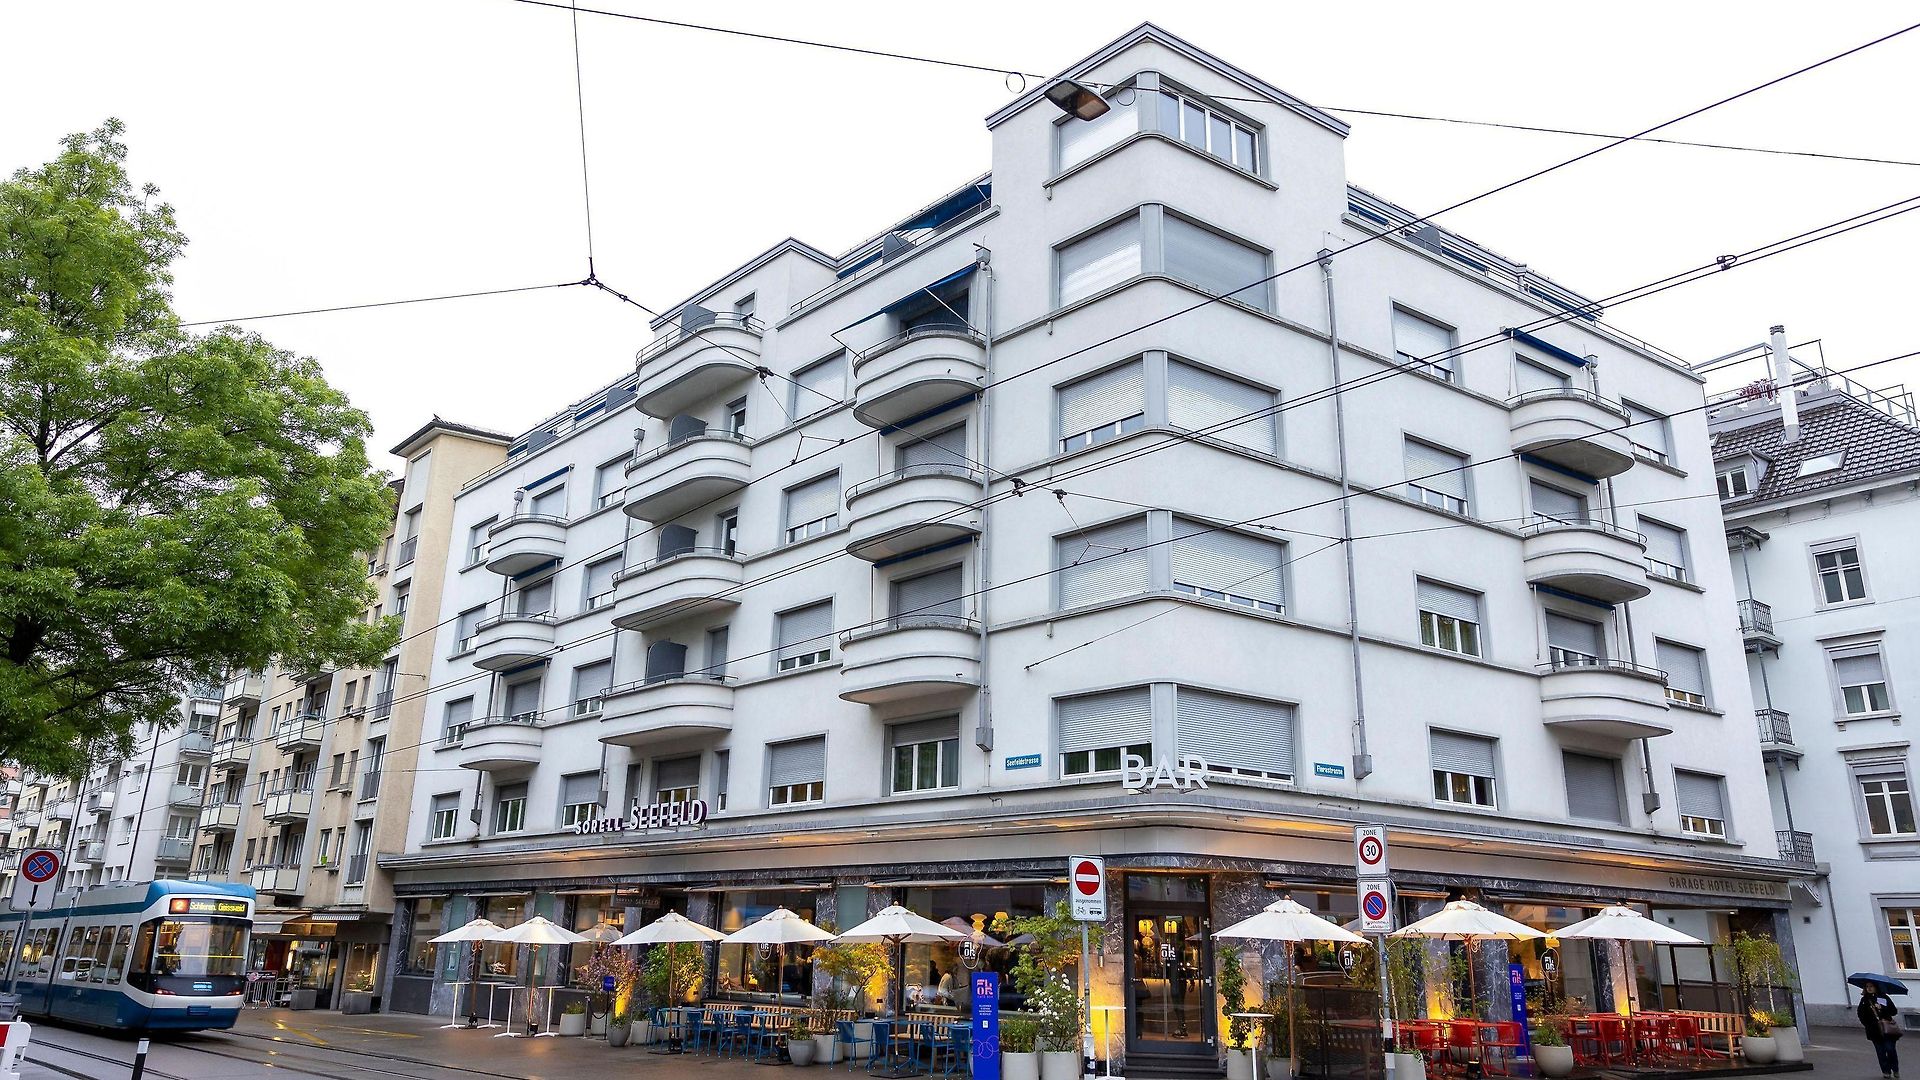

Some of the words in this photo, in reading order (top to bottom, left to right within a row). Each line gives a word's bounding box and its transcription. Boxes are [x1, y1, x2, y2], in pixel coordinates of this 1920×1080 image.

[1006, 757, 1039, 767] Seefeldstrasse
[1121, 753, 1208, 789] BAR
[1316, 764, 1343, 775] Florastrasse
[575, 817, 622, 835] SORELL
[629, 799, 708, 830] SEEFELD
[1365, 845, 1377, 857] 30
[1669, 876, 1706, 891] GARAGE
[1708, 880, 1736, 893] HOTEL
[1738, 882, 1776, 896] SEEFELD
[175, 901, 184, 910] 2
